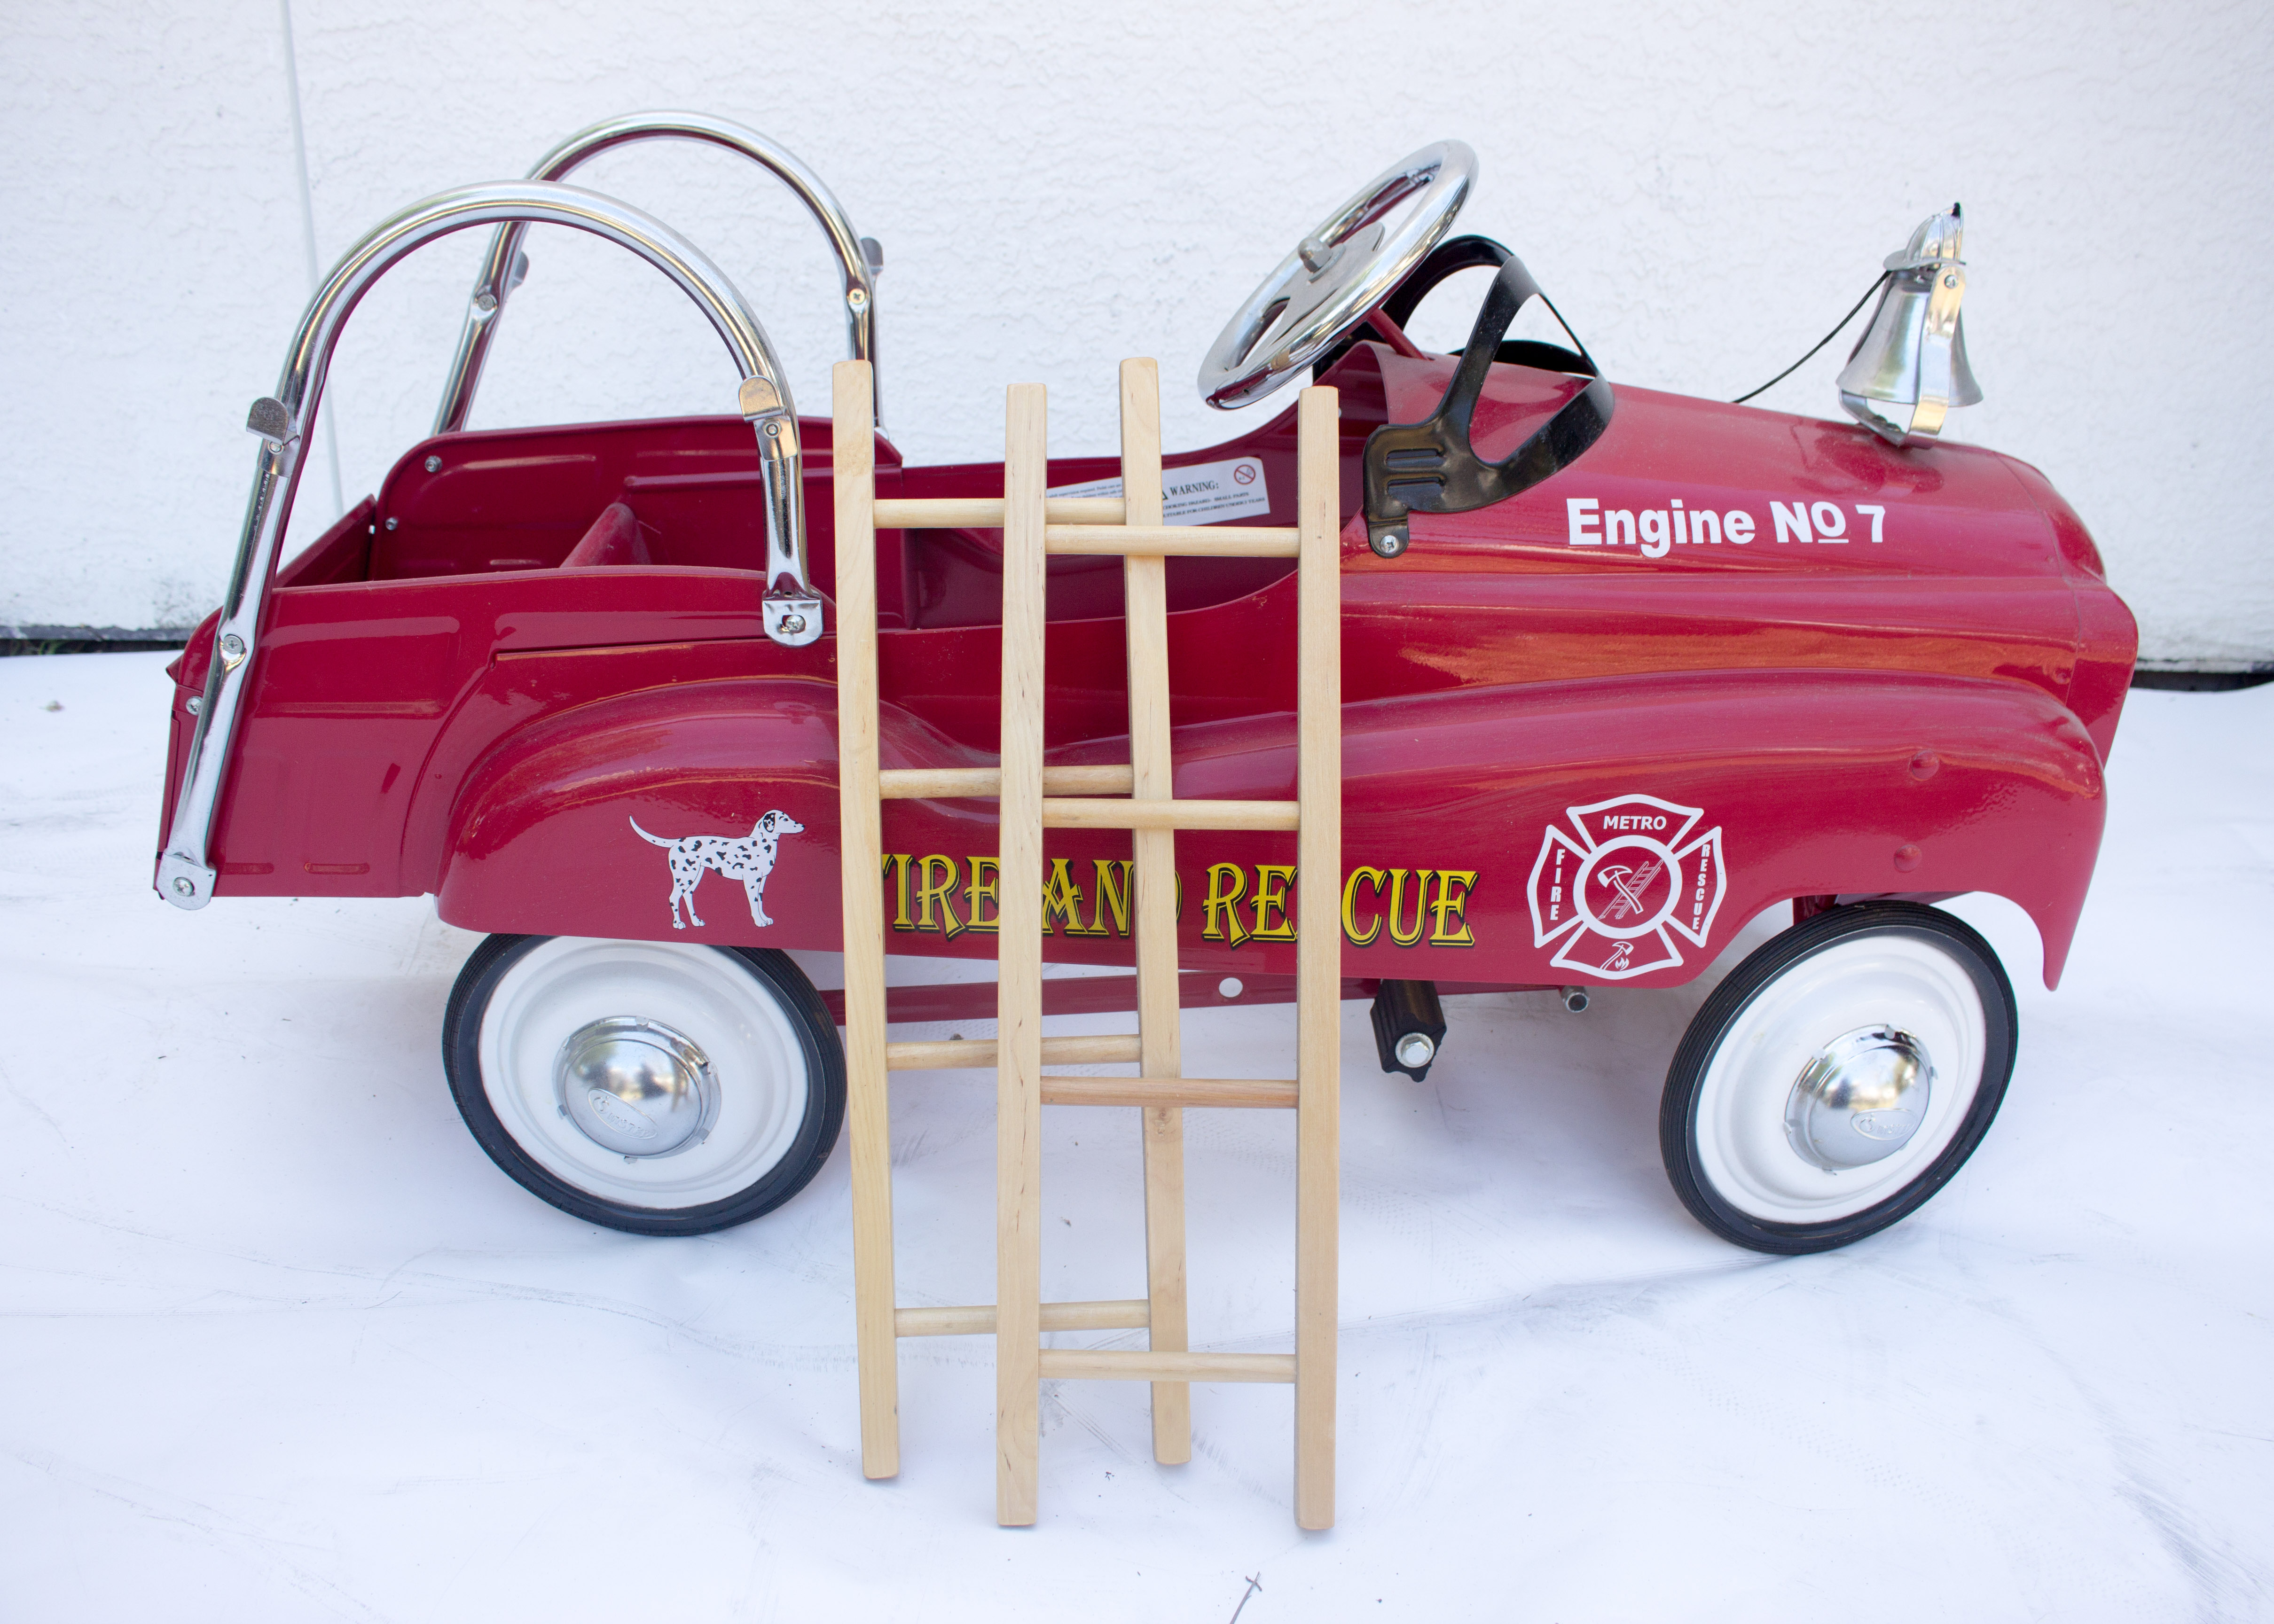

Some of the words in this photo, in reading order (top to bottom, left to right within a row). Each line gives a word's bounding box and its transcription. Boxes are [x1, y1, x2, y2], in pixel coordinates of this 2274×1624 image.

[1170, 480, 1219, 496] WARNING:
[1567, 498, 1755, 558] Engine
[1855, 505, 1885, 543] 7
[1603, 816, 1667, 830] METRO
[882, 853, 999, 941] IRE
[1202, 863, 1479, 950] RECUE
[1550, 849, 1565, 920] FIRE
[1692, 844, 1710, 930] RESCUE
